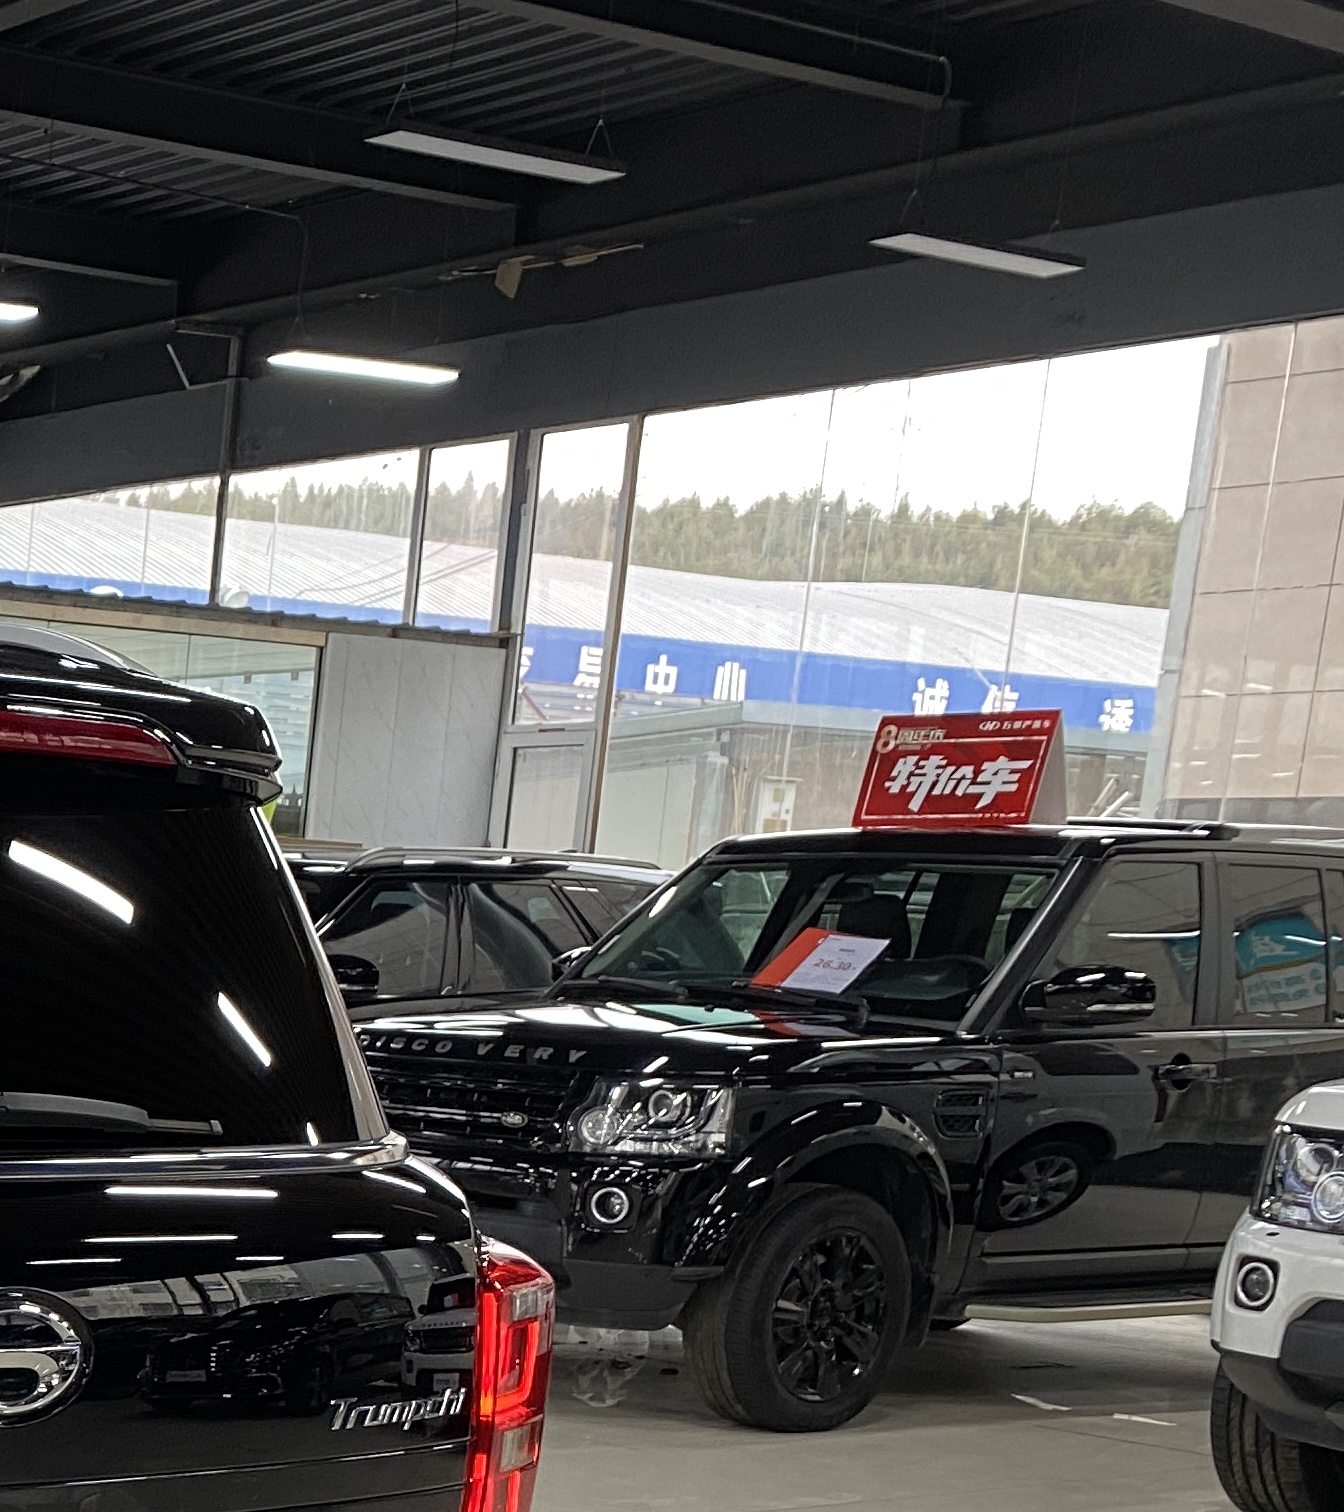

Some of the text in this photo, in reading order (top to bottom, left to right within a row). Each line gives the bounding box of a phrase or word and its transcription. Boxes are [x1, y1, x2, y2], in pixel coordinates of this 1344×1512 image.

[884, 754, 1034, 813] 特价车
[330, 1388, 468, 1433] Trumpchi
